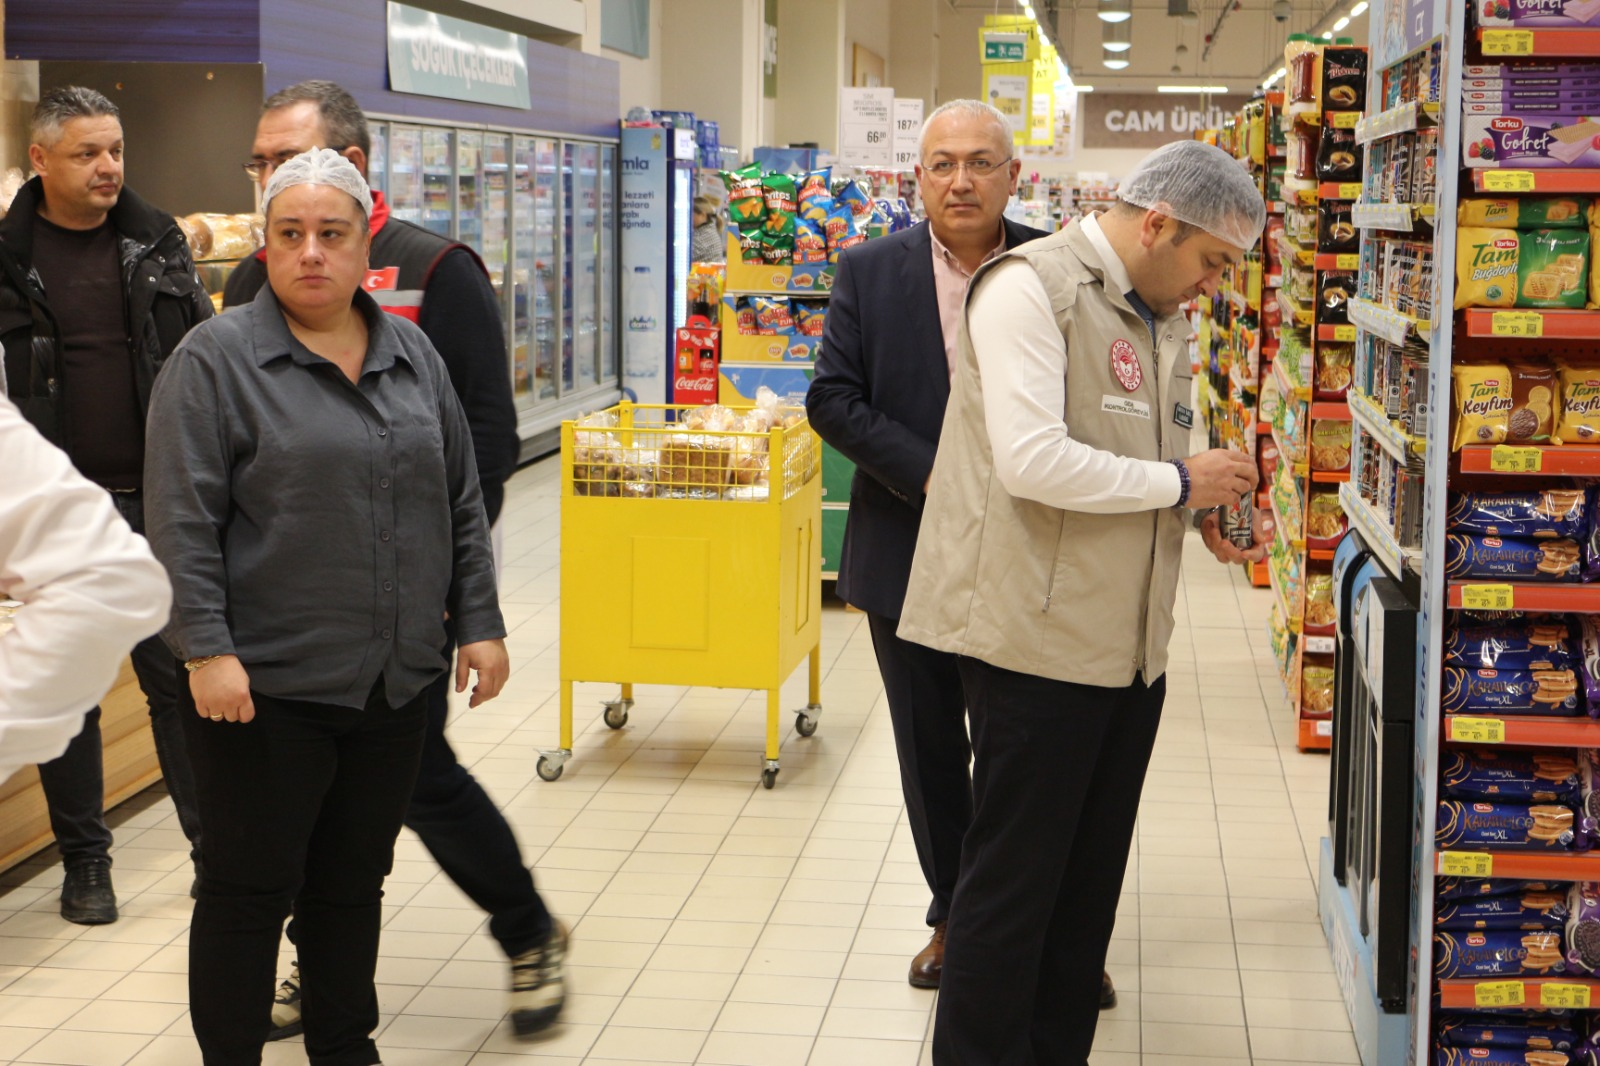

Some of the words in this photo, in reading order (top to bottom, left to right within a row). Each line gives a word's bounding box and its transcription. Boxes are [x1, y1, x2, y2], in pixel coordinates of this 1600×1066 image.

[897, 119, 912, 130] 187
[1105, 109, 1165, 132] CAM
[1494, 119, 1520, 128] Torku
[867, 131, 879, 143] 66
[1501, 126, 1549, 150] Gofret
[896, 152, 911, 162] 187
[624, 191, 654, 199] lezzeti
[765, 191, 791, 201] oritos
[1485, 203, 1508, 216] Tam
[1472, 244, 1518, 267] Tam
[1472, 264, 1518, 282] Buğdaylı
[1470, 383, 1500, 399] Tam
[1563, 395, 1600, 414] Keyfi
[1503, 563, 1517, 573] XL
[1499, 695, 1513, 705] XL
[1502, 769, 1515, 778] XL
[1494, 829, 1508, 840] XL
[1489, 901, 1503, 912] XL
[1489, 962, 1503, 973] XL
